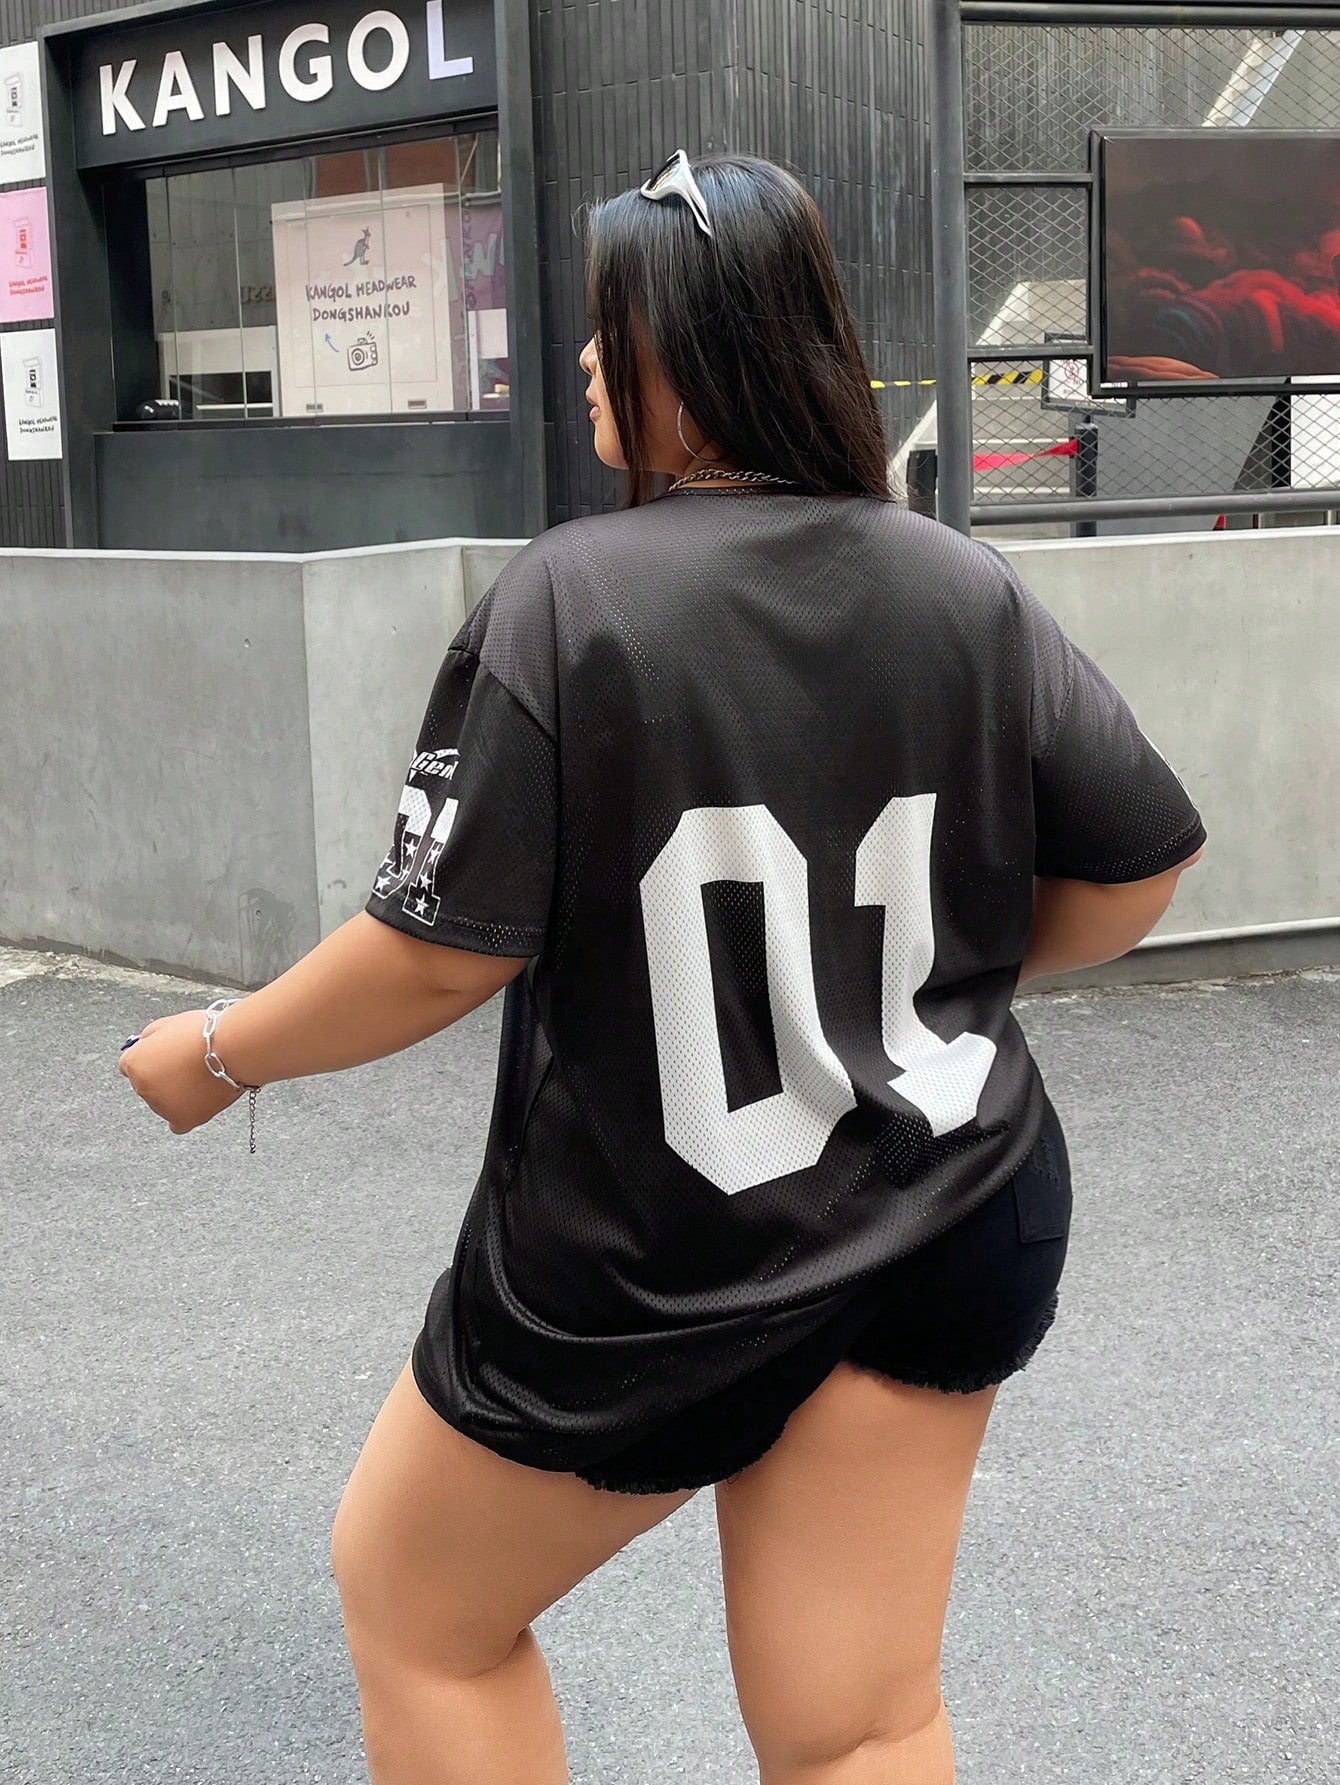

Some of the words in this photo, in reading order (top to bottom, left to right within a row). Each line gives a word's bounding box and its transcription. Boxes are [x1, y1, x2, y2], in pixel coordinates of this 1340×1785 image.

[99, 0, 474, 135] KANGOL
[305, 283, 352, 302] KANGOL
[356, 275, 417, 297] HEADWEAR
[312, 301, 410, 322] DONGSHANKOU
[639, 793, 998, 1196] 01
